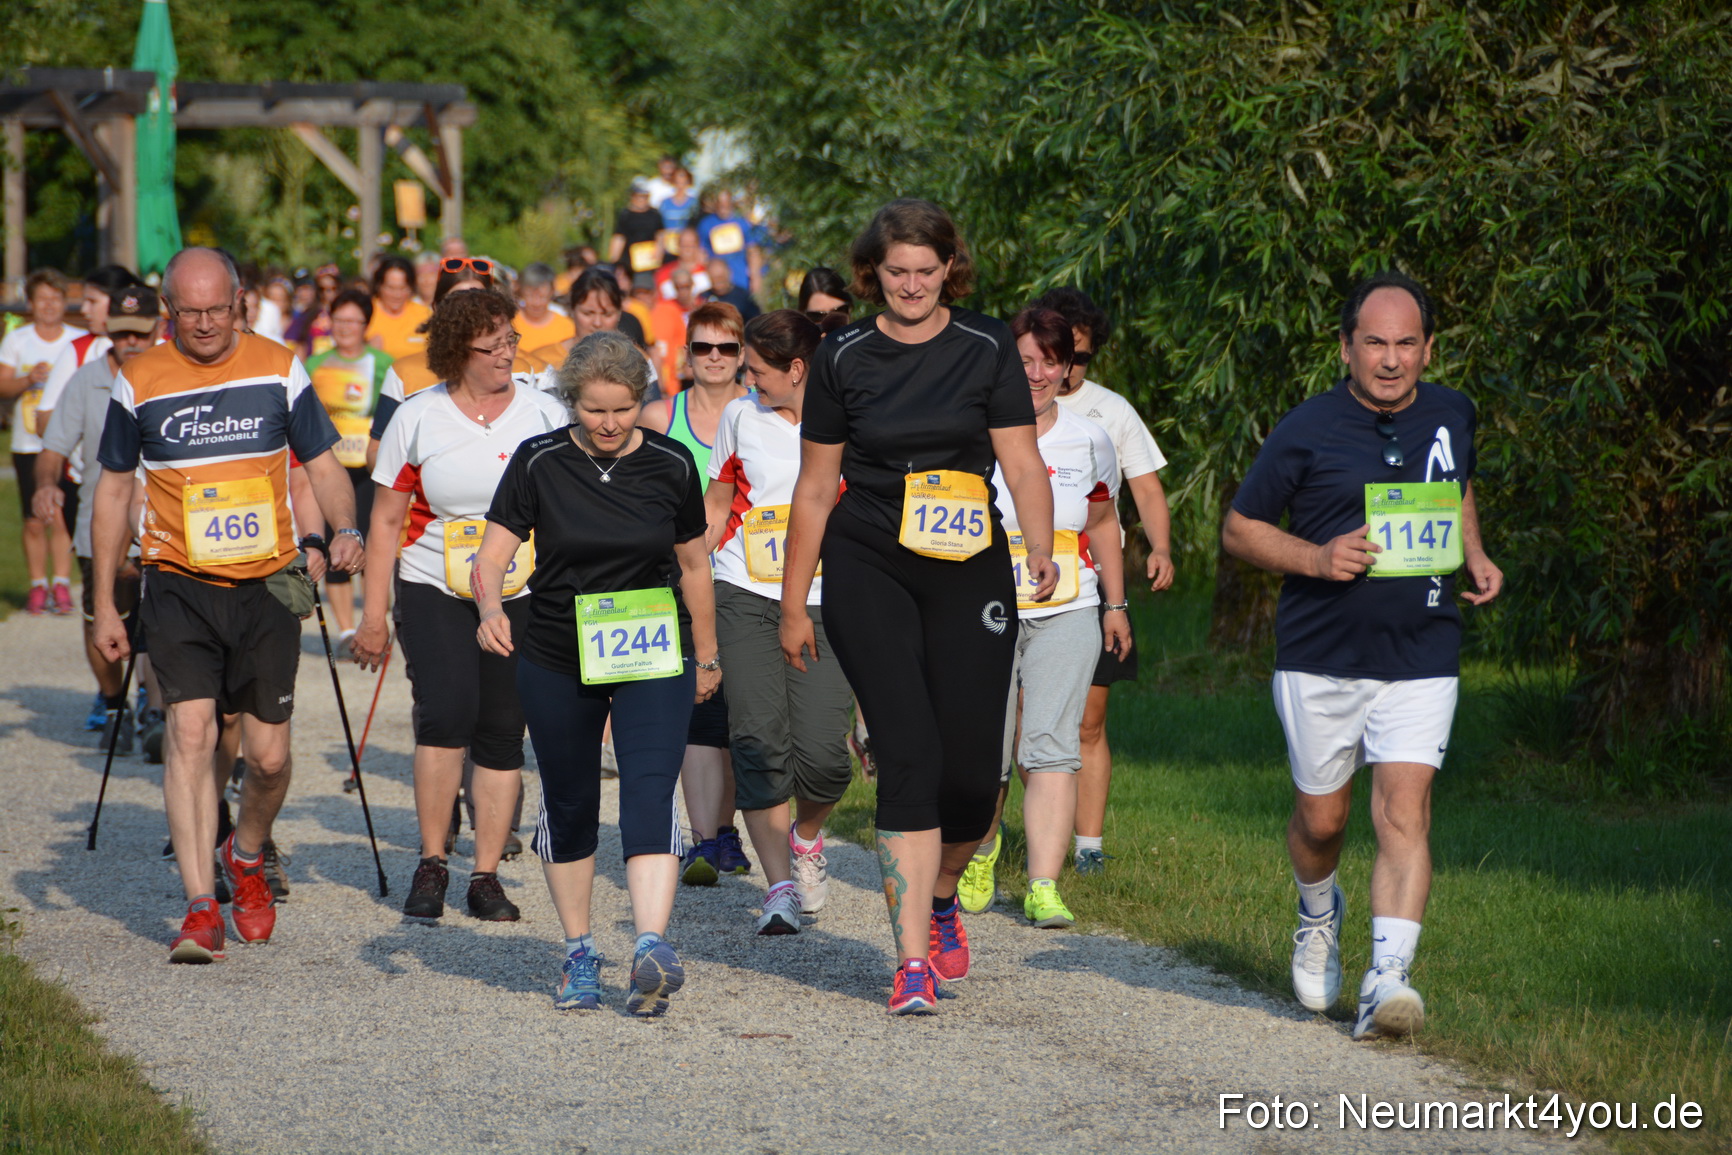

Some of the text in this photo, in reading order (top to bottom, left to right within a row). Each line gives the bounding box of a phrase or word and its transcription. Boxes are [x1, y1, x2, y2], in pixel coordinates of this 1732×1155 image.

[180, 416, 263, 438] Fischer
[188, 431, 258, 446] AUTOMOBILE
[205, 512, 259, 541] 466
[915, 504, 984, 537] 1245
[1378, 520, 1453, 550] 1147
[593, 606, 627, 616] firmenlauf
[590, 624, 671, 658] 1244
